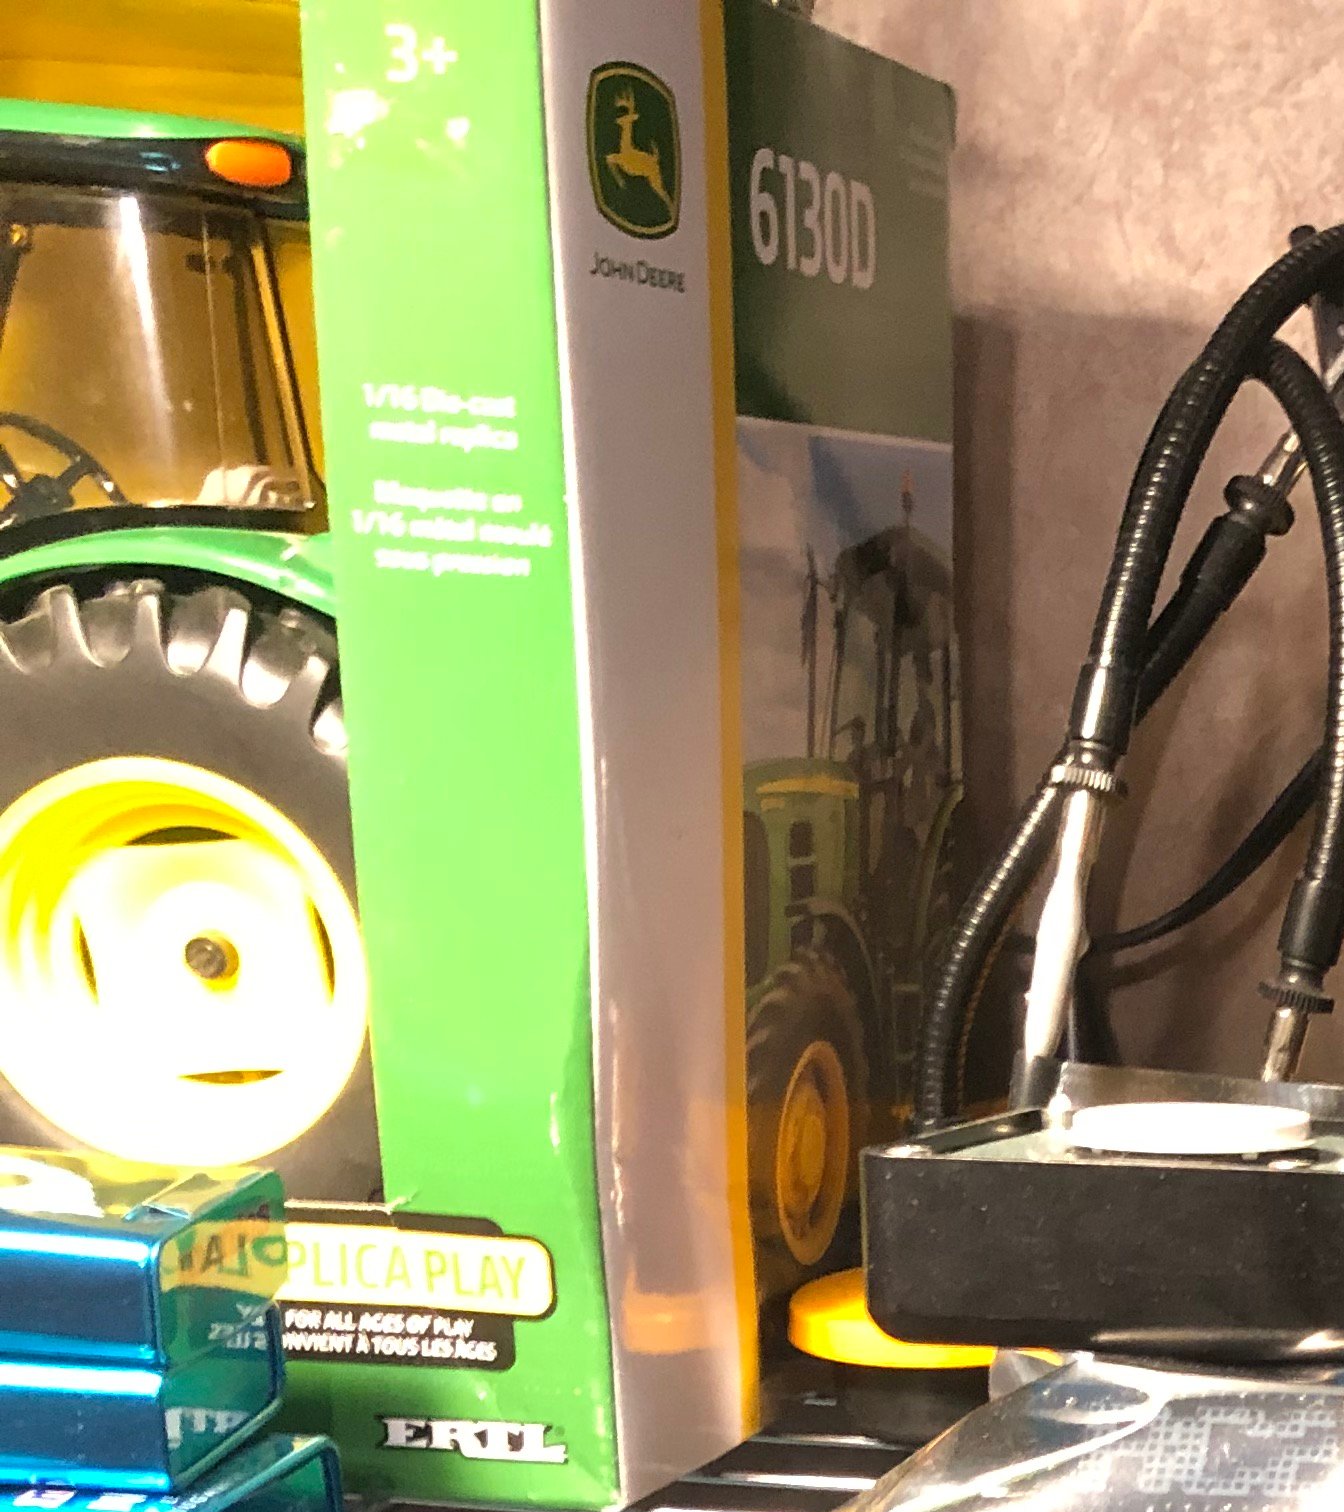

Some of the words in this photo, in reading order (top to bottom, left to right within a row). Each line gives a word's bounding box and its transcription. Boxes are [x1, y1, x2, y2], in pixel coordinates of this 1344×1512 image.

[384, 23, 459, 82] 3+
[751, 147, 876, 290] 6130D
[589, 251, 634, 284] JOHN
[636, 260, 686, 293] DEERE
[286, 1238, 412, 1292] PLICA
[423, 1247, 526, 1301] PLAY
[284, 1308, 322, 1330] FOR
[323, 1310, 357, 1332] ALL
[358, 1312, 405, 1334] AGES
[406, 1314, 432, 1335] OF
[433, 1316, 474, 1338] PLAY
[371, 1335, 420, 1356] TOUS
[421, 1338, 453, 1358] LES
[375, 1414, 568, 1466] ERTL
